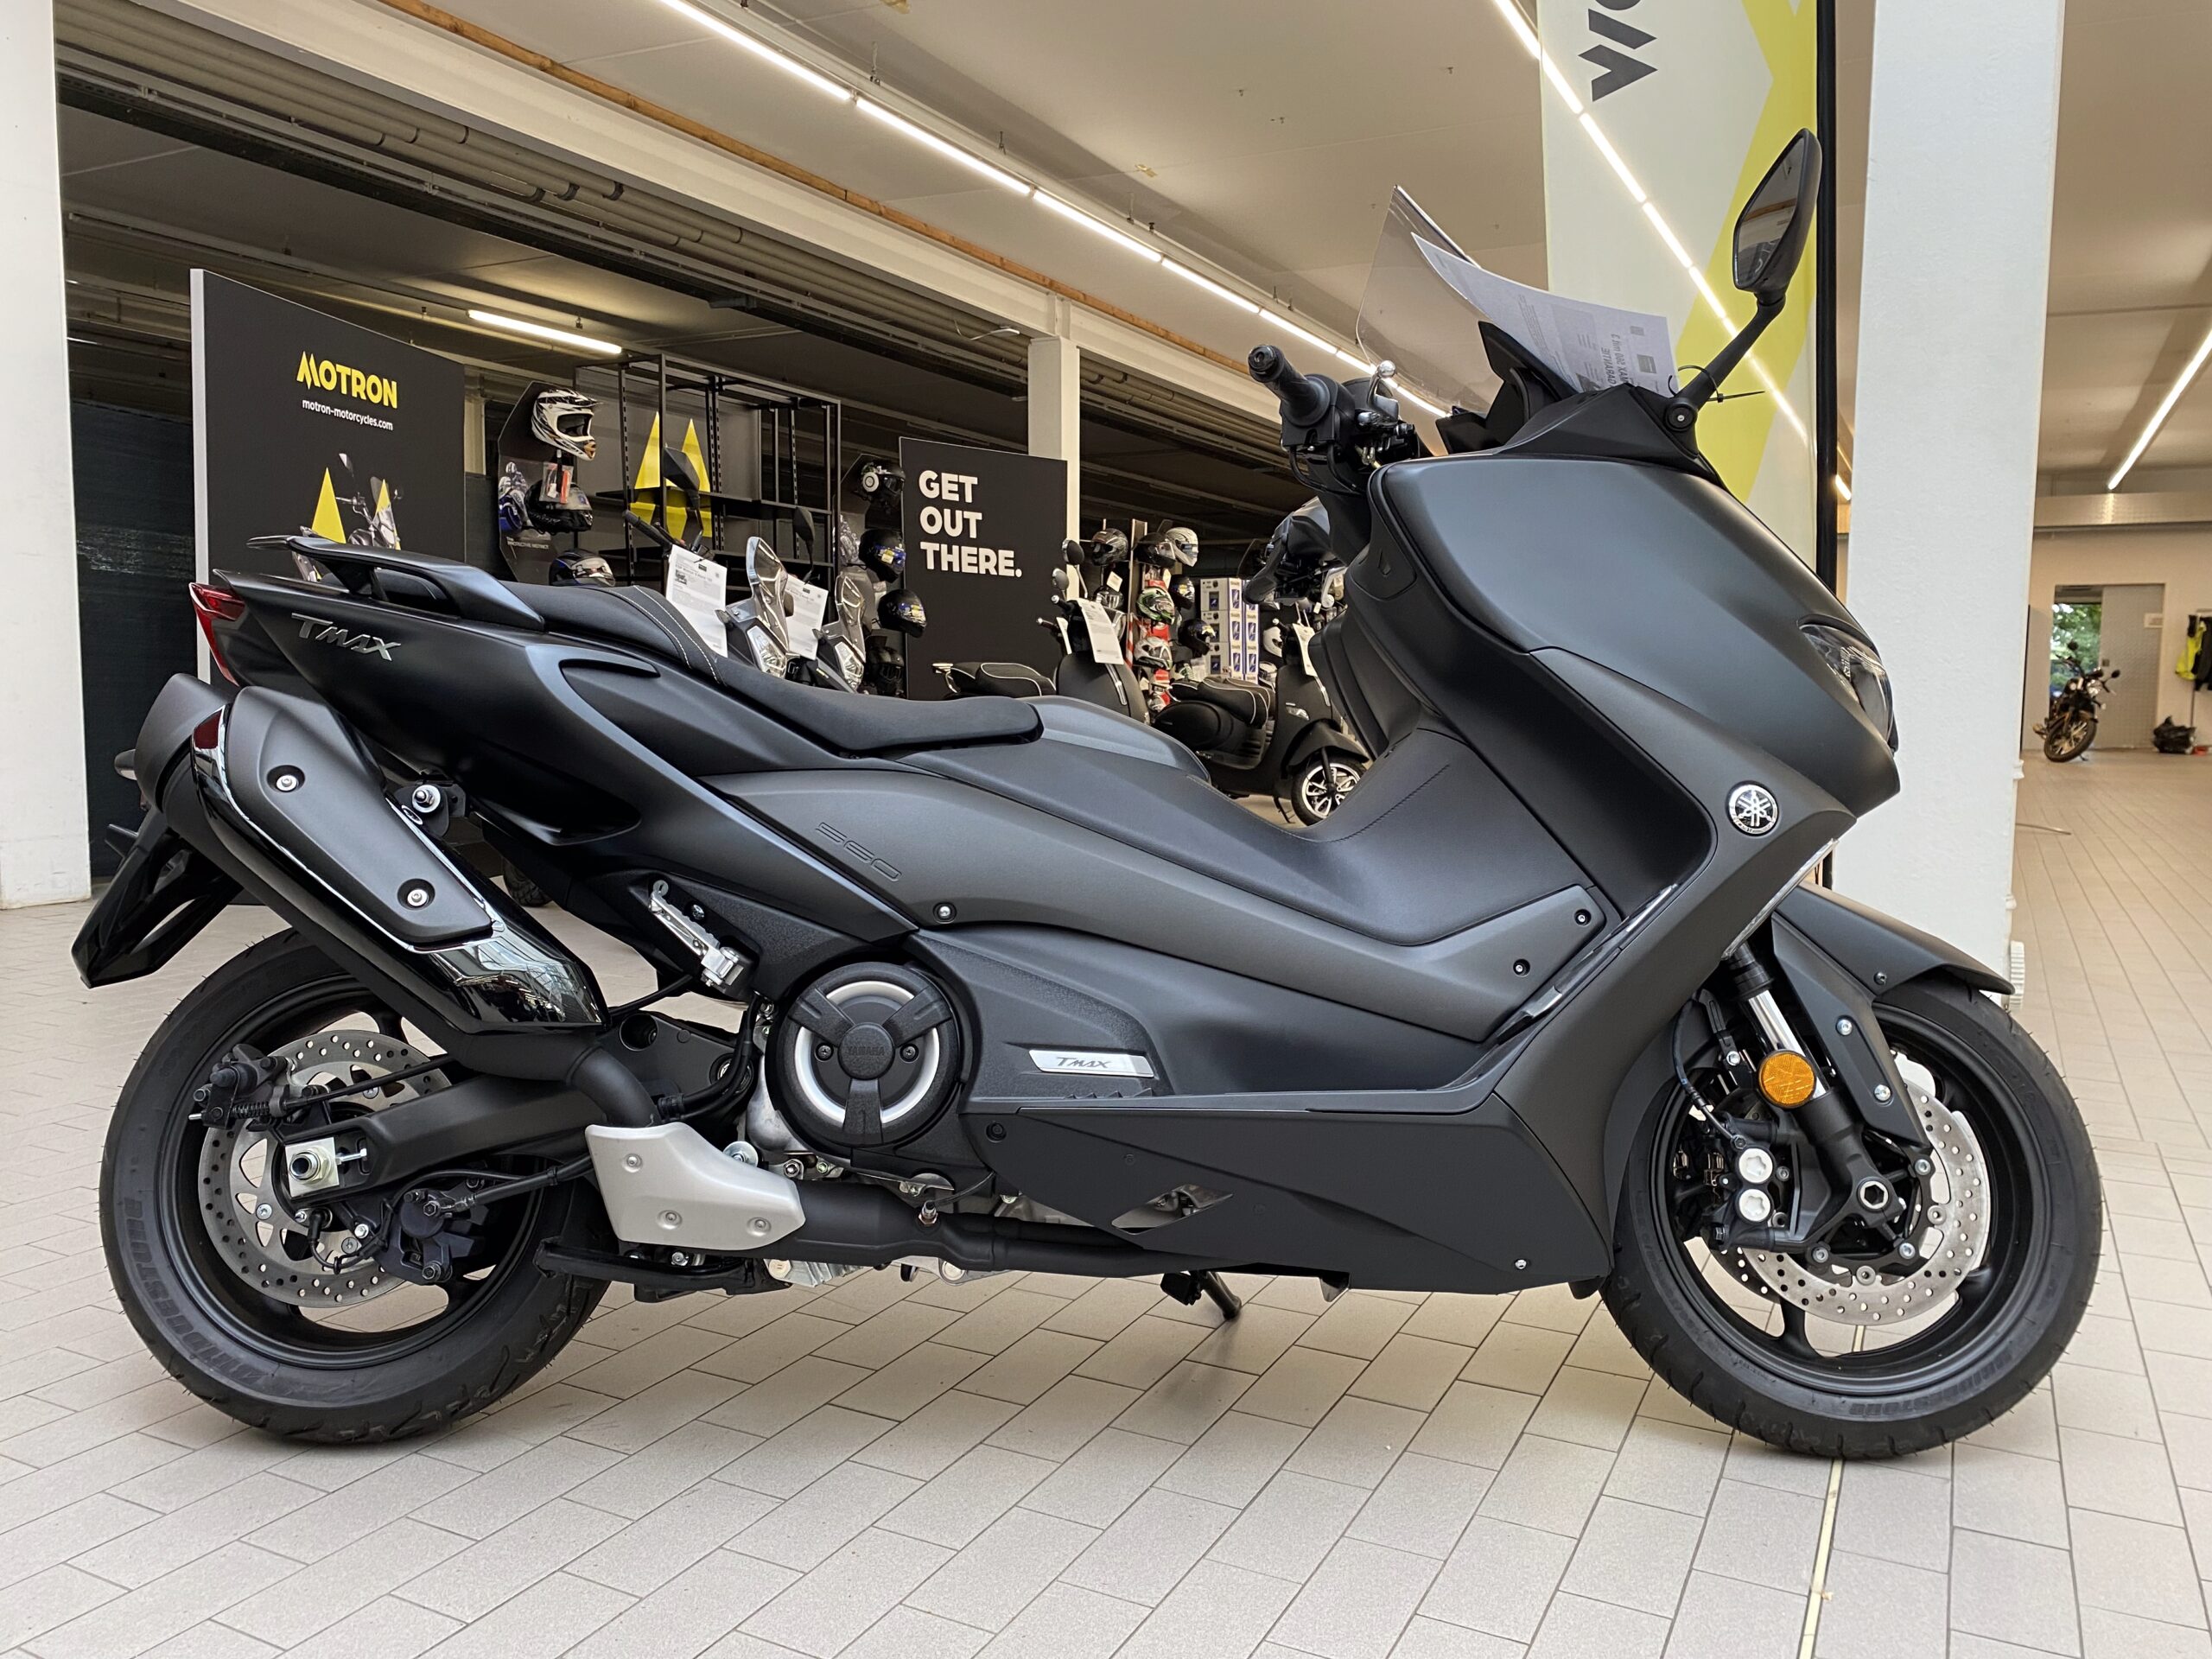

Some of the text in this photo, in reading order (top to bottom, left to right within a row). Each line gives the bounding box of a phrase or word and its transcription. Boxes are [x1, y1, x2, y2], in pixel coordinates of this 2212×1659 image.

[296, 351, 397, 409] MOTRON
[302, 399, 393, 431] motron-motorcycles.com
[918, 470, 978, 503] GET
[919, 506, 982, 538] OUT
[919, 541, 1022, 578] THERE.
